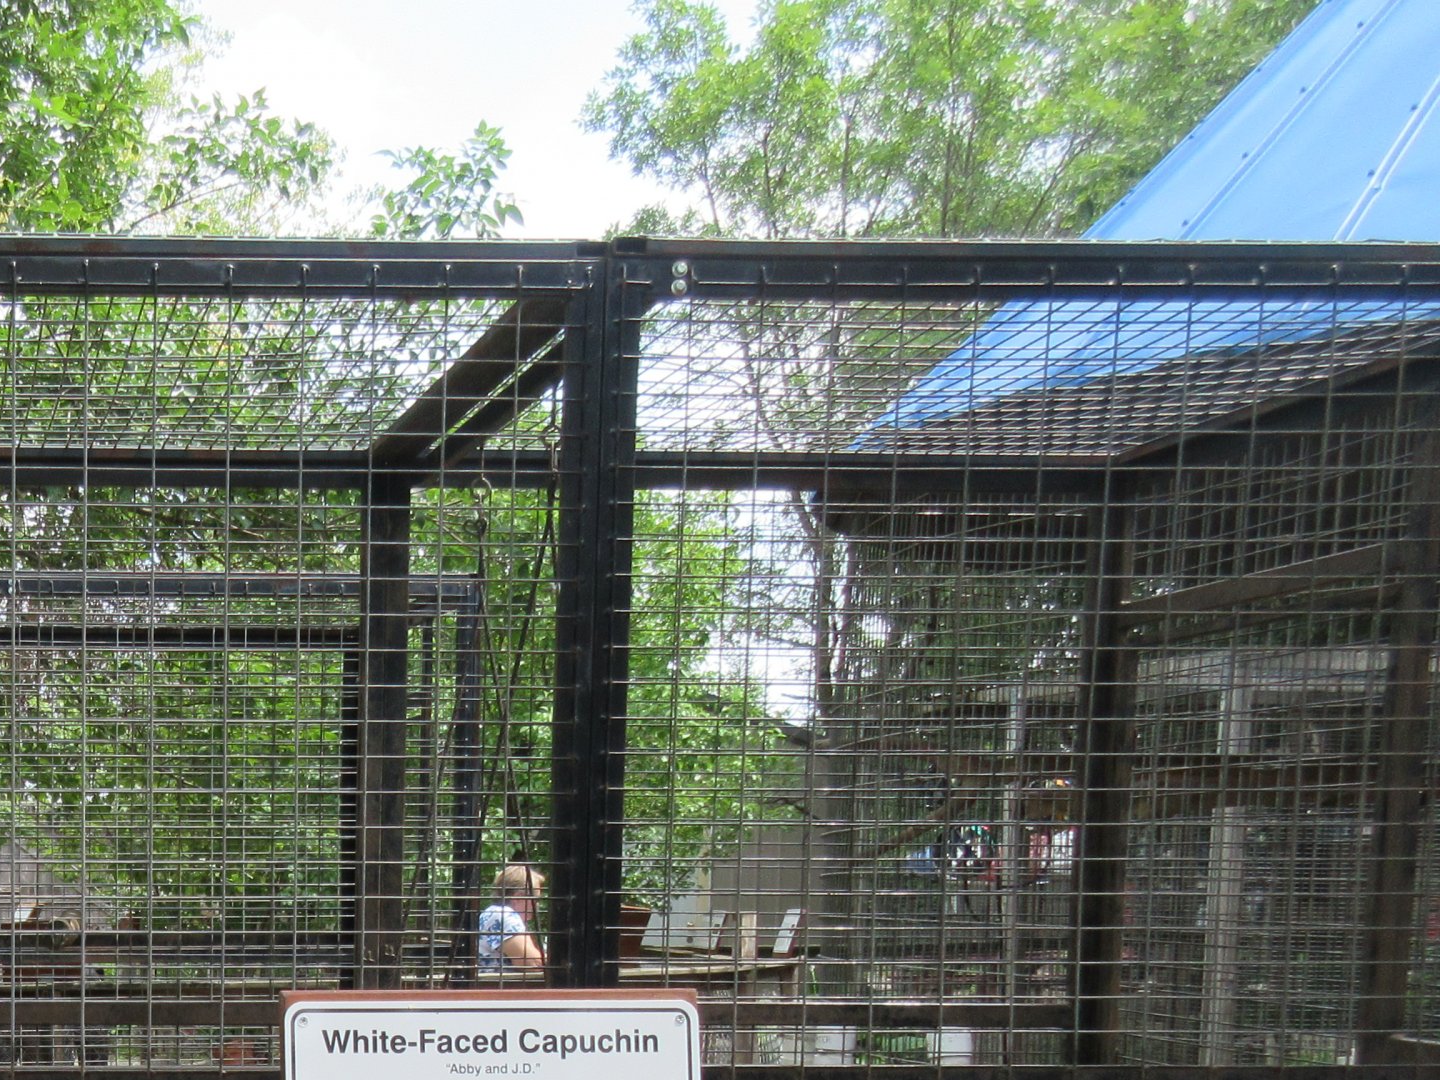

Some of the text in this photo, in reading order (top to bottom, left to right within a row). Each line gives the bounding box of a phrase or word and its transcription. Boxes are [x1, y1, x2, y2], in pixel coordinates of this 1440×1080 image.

[322, 1029, 658, 1059] White-Faced Capuchin
[486, 1064, 507, 1073] and
